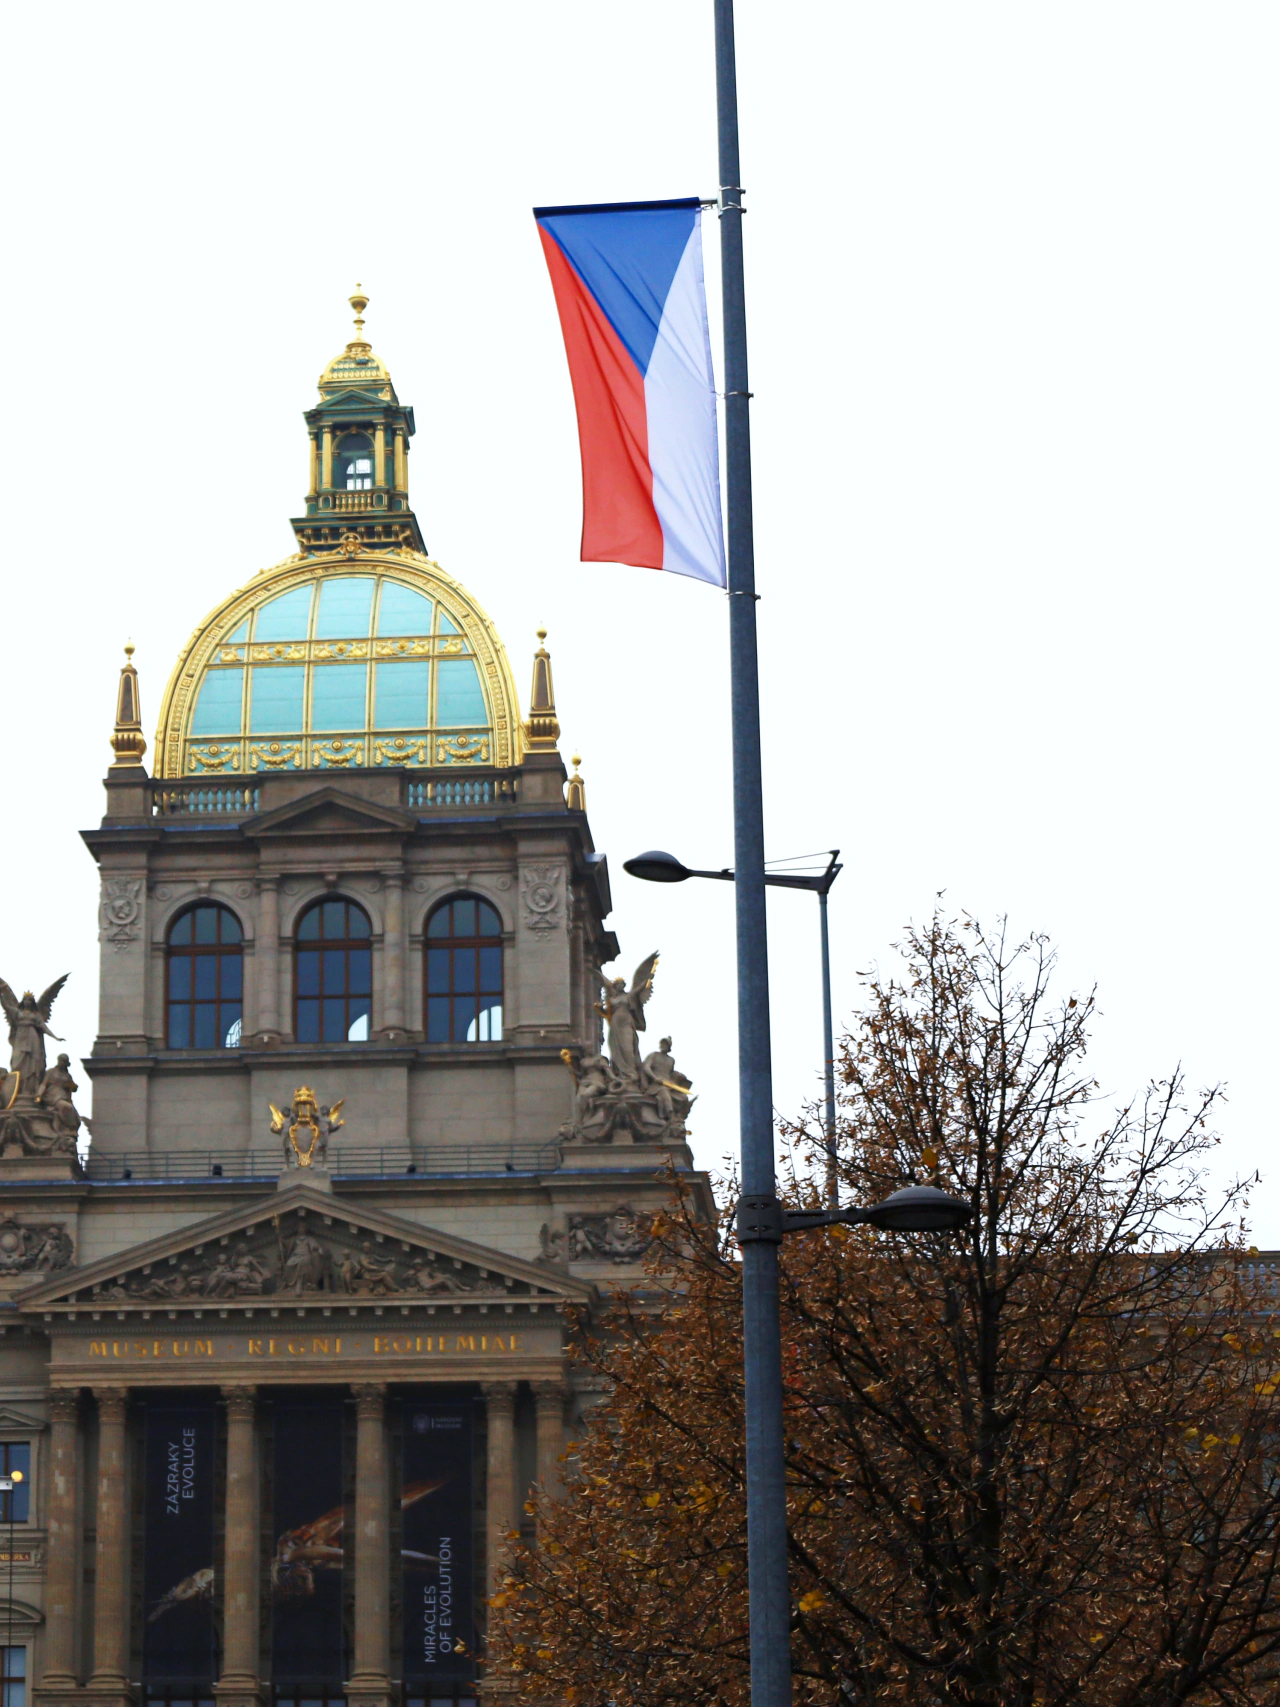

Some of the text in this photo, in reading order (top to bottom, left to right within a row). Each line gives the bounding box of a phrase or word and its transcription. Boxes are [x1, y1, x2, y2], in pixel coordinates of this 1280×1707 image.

[89, 1335, 524, 1357] MUSEUM REGNI BOHEMIAE
[165, 1441, 179, 1514] ZÁZRAKY
[182, 1428, 195, 1498] EVOLUCE
[424, 1585, 436, 1662] MIRACLES
[439, 1537, 452, 1653] OF EVOLUTION
